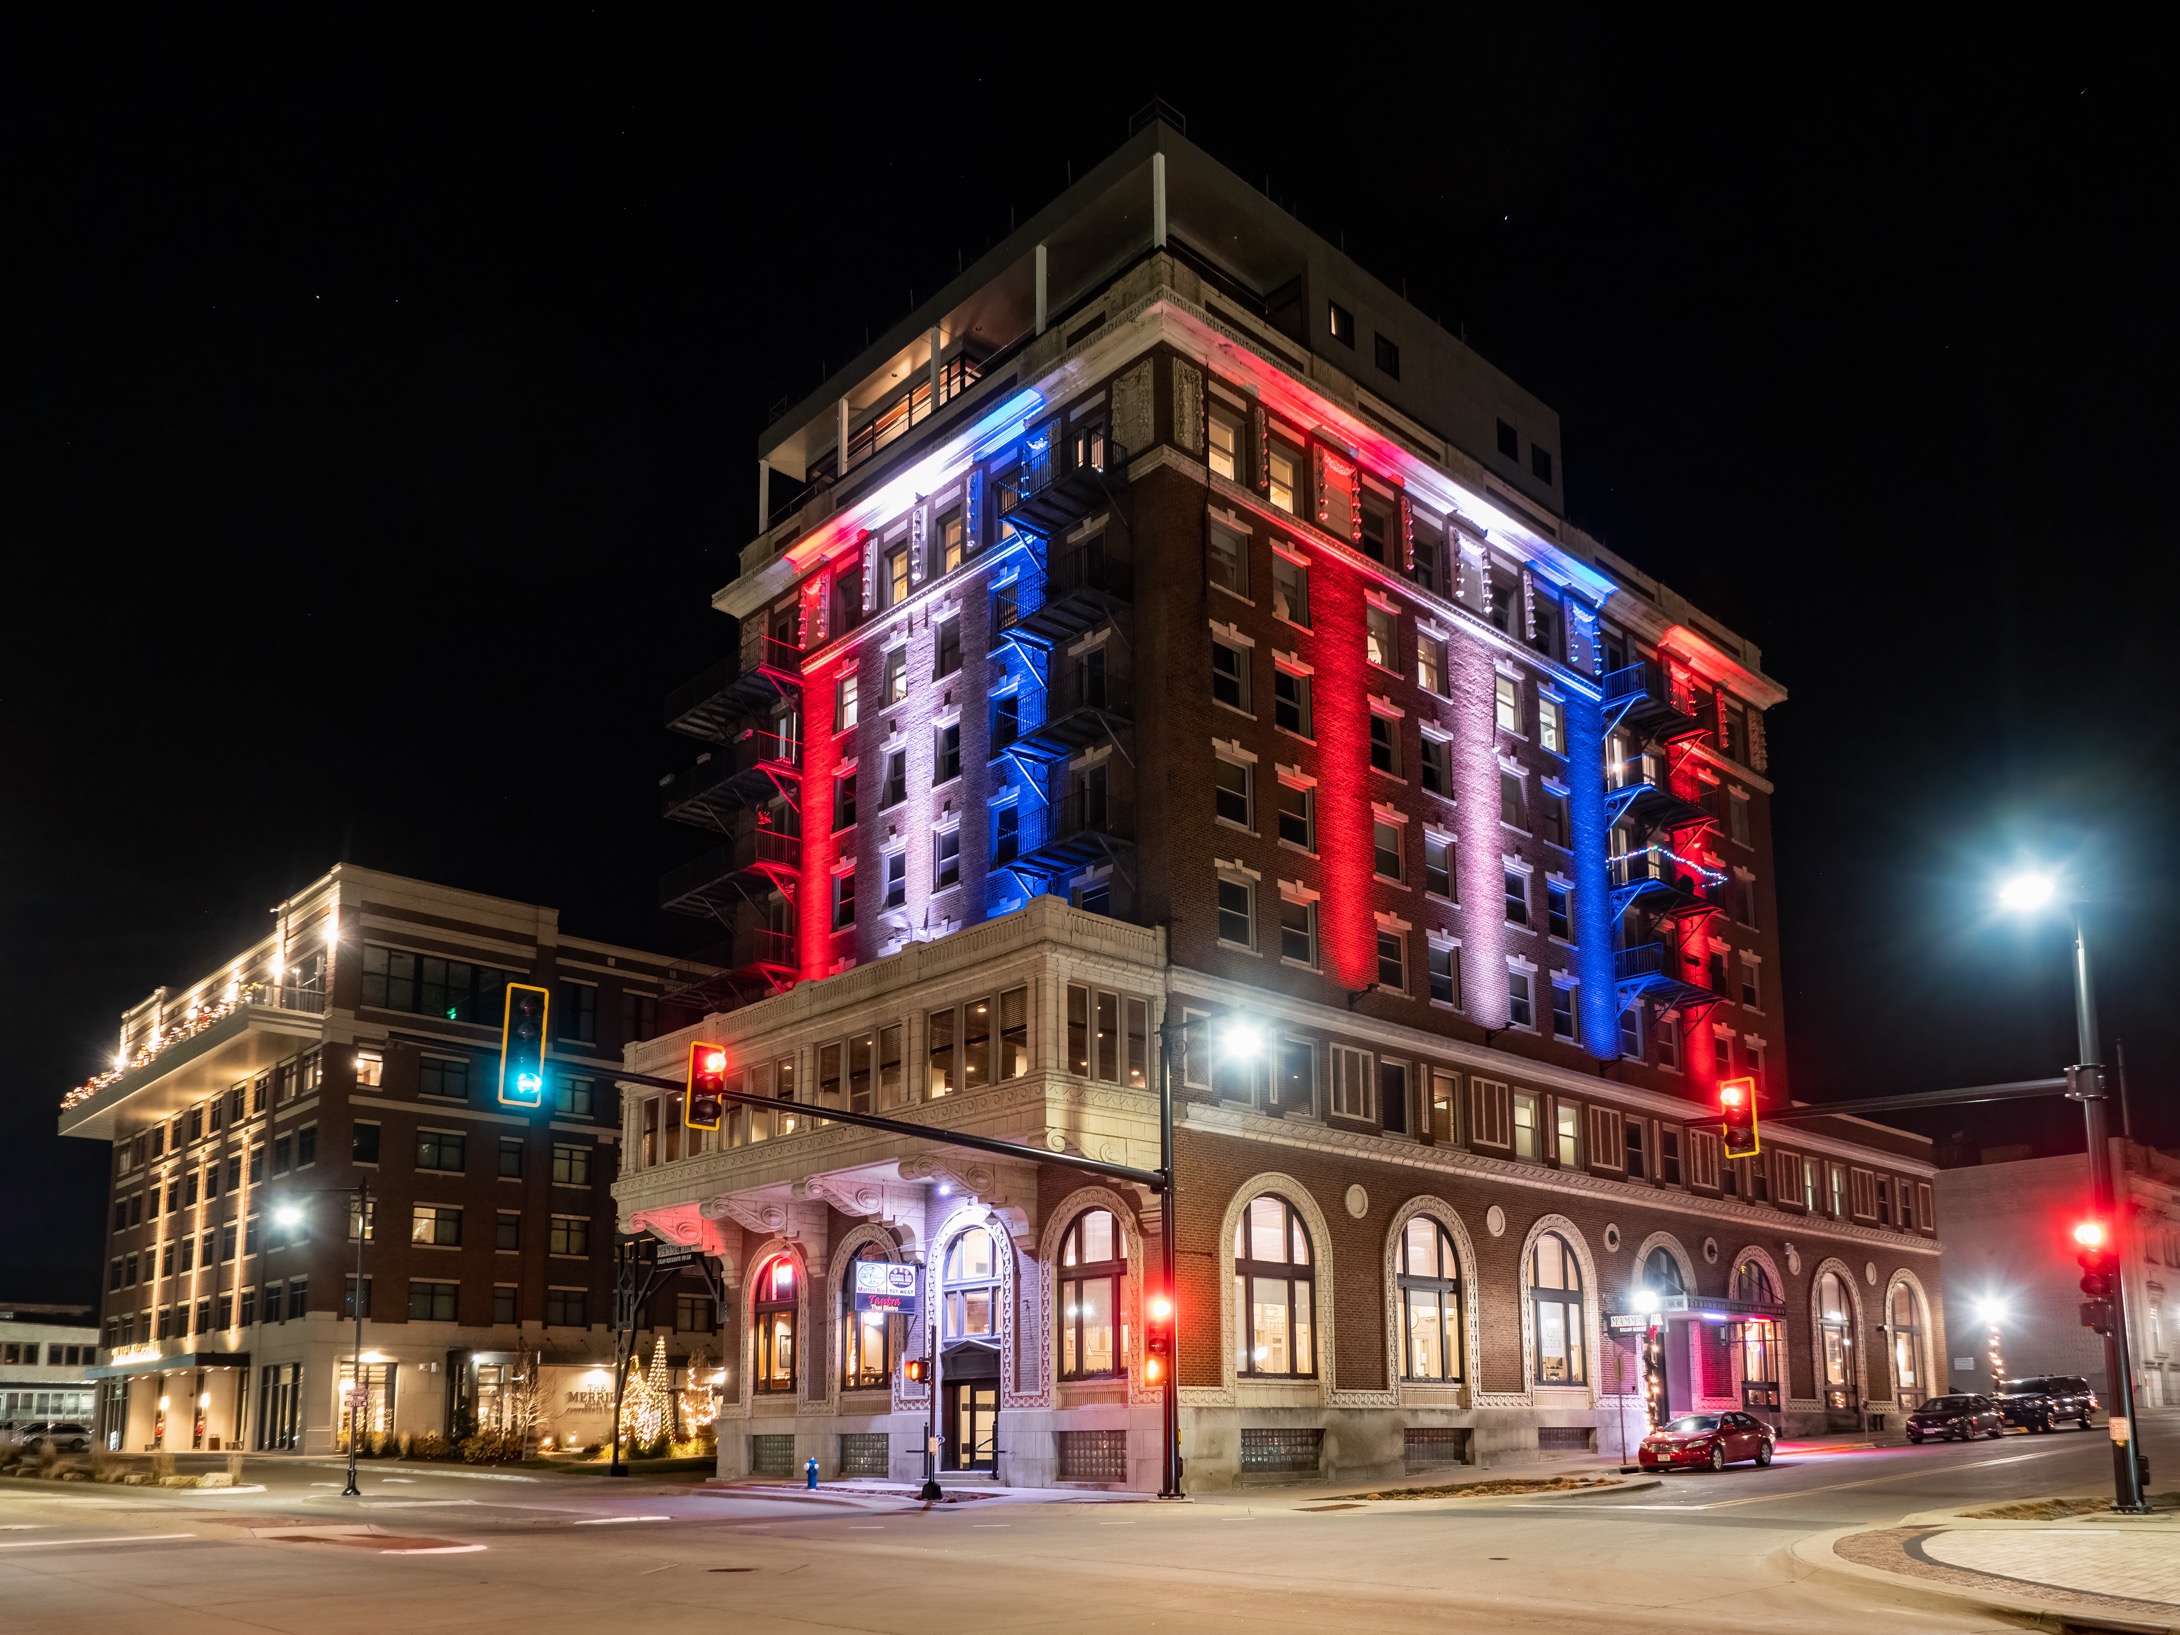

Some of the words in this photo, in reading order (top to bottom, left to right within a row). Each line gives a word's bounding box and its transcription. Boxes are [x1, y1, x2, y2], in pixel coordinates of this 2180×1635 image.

[868, 1295, 900, 1306] Tantra
[1610, 1316, 1646, 1327] MAMMA
[587, 1384, 606, 1392] THE
